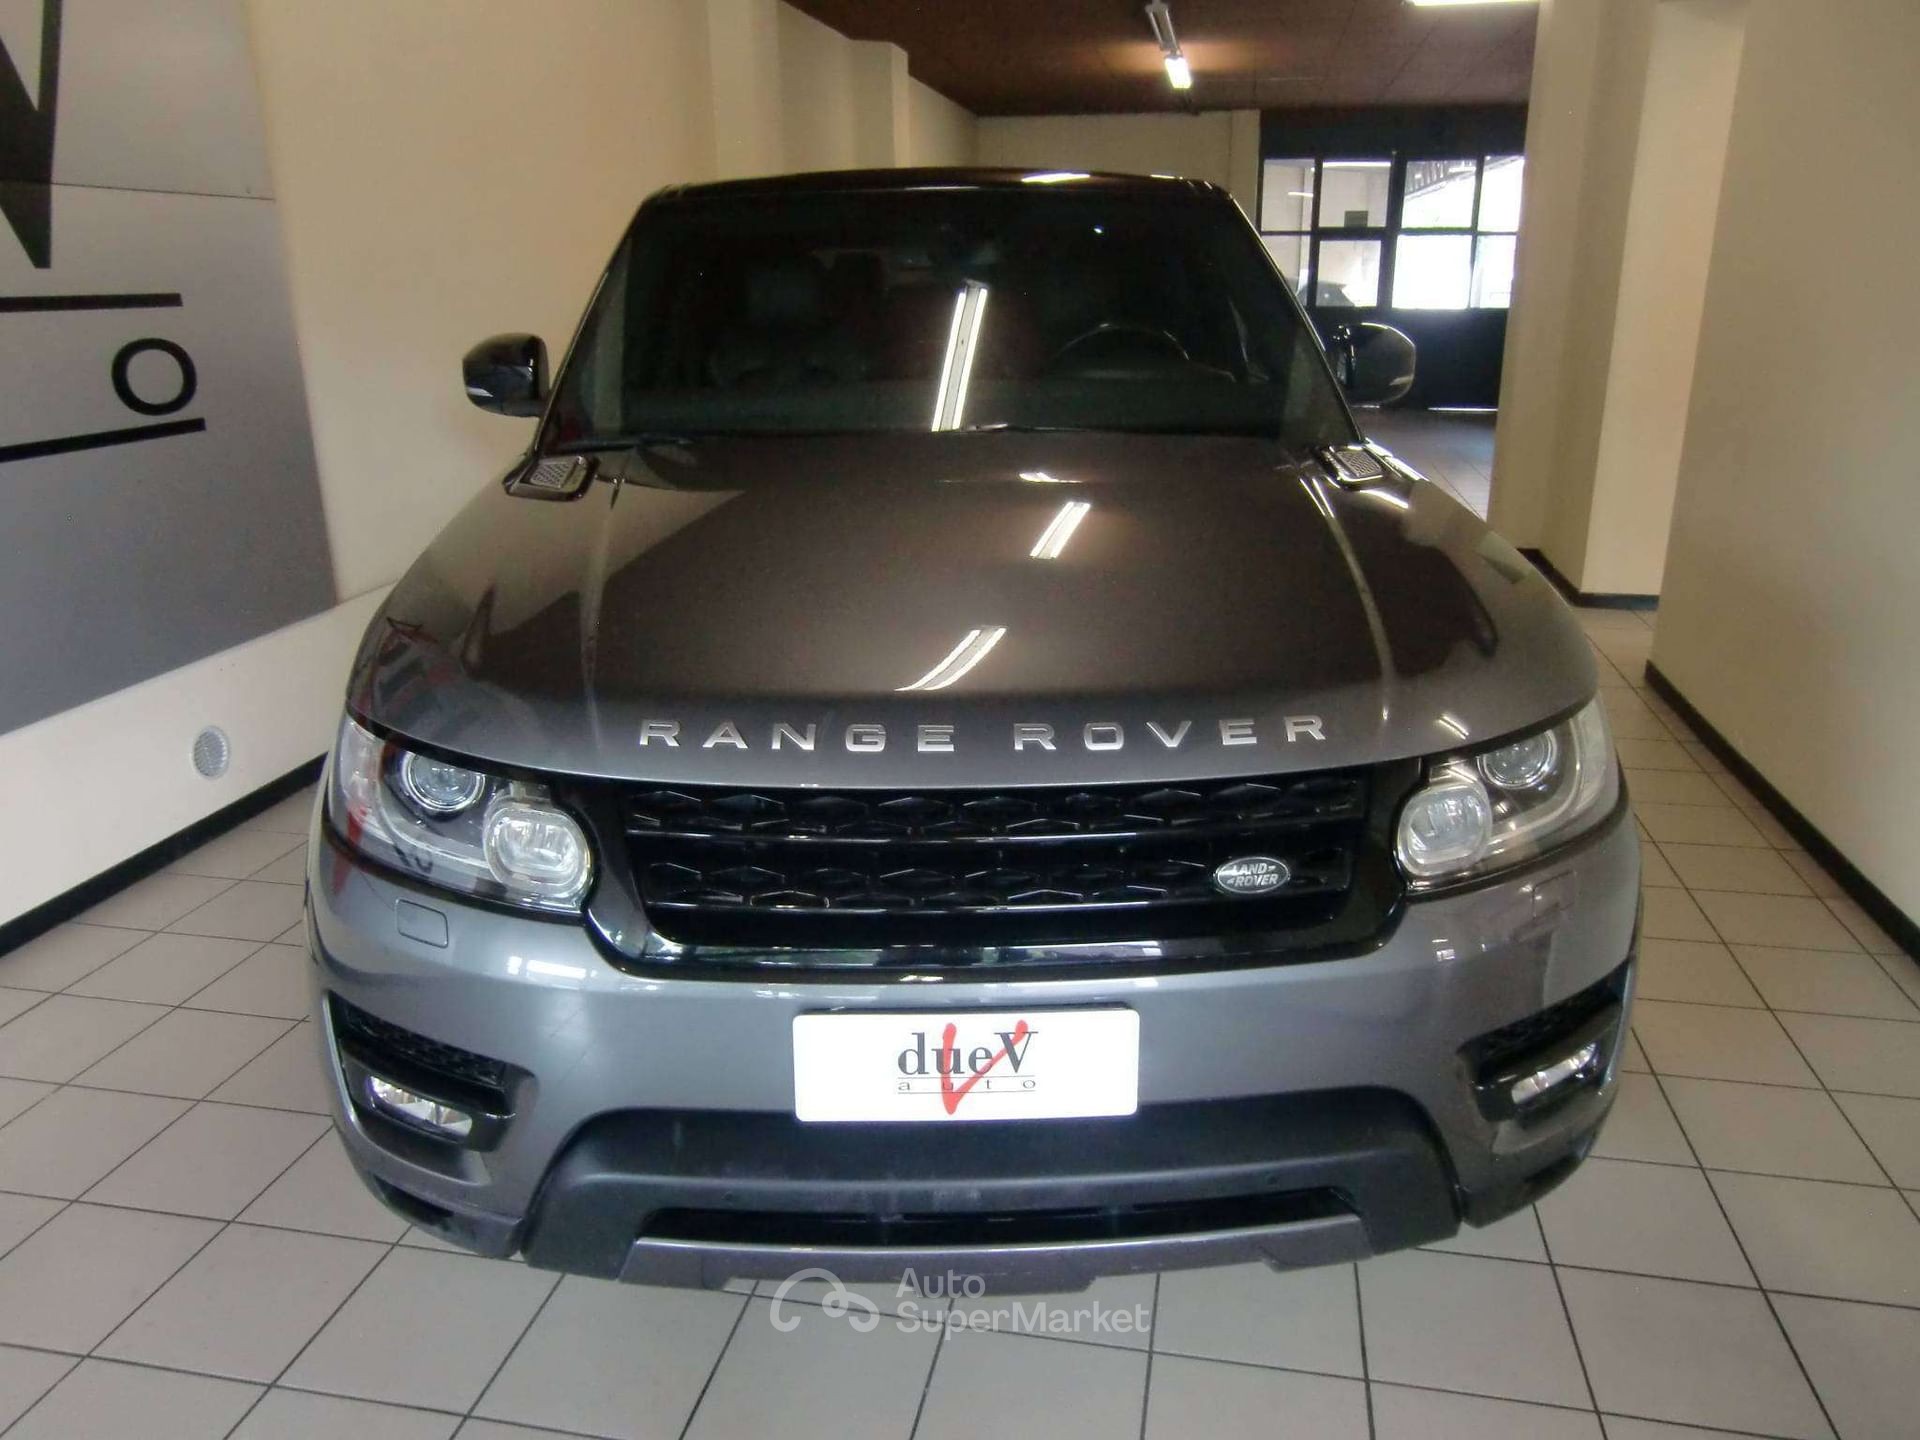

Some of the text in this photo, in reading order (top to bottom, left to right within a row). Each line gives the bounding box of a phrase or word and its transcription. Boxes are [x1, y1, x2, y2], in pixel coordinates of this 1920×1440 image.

[639, 715, 1326, 752] RANGE ROVER
[1234, 873, 1279, 888] ROVER
[898, 1078, 1036, 1091] auto
